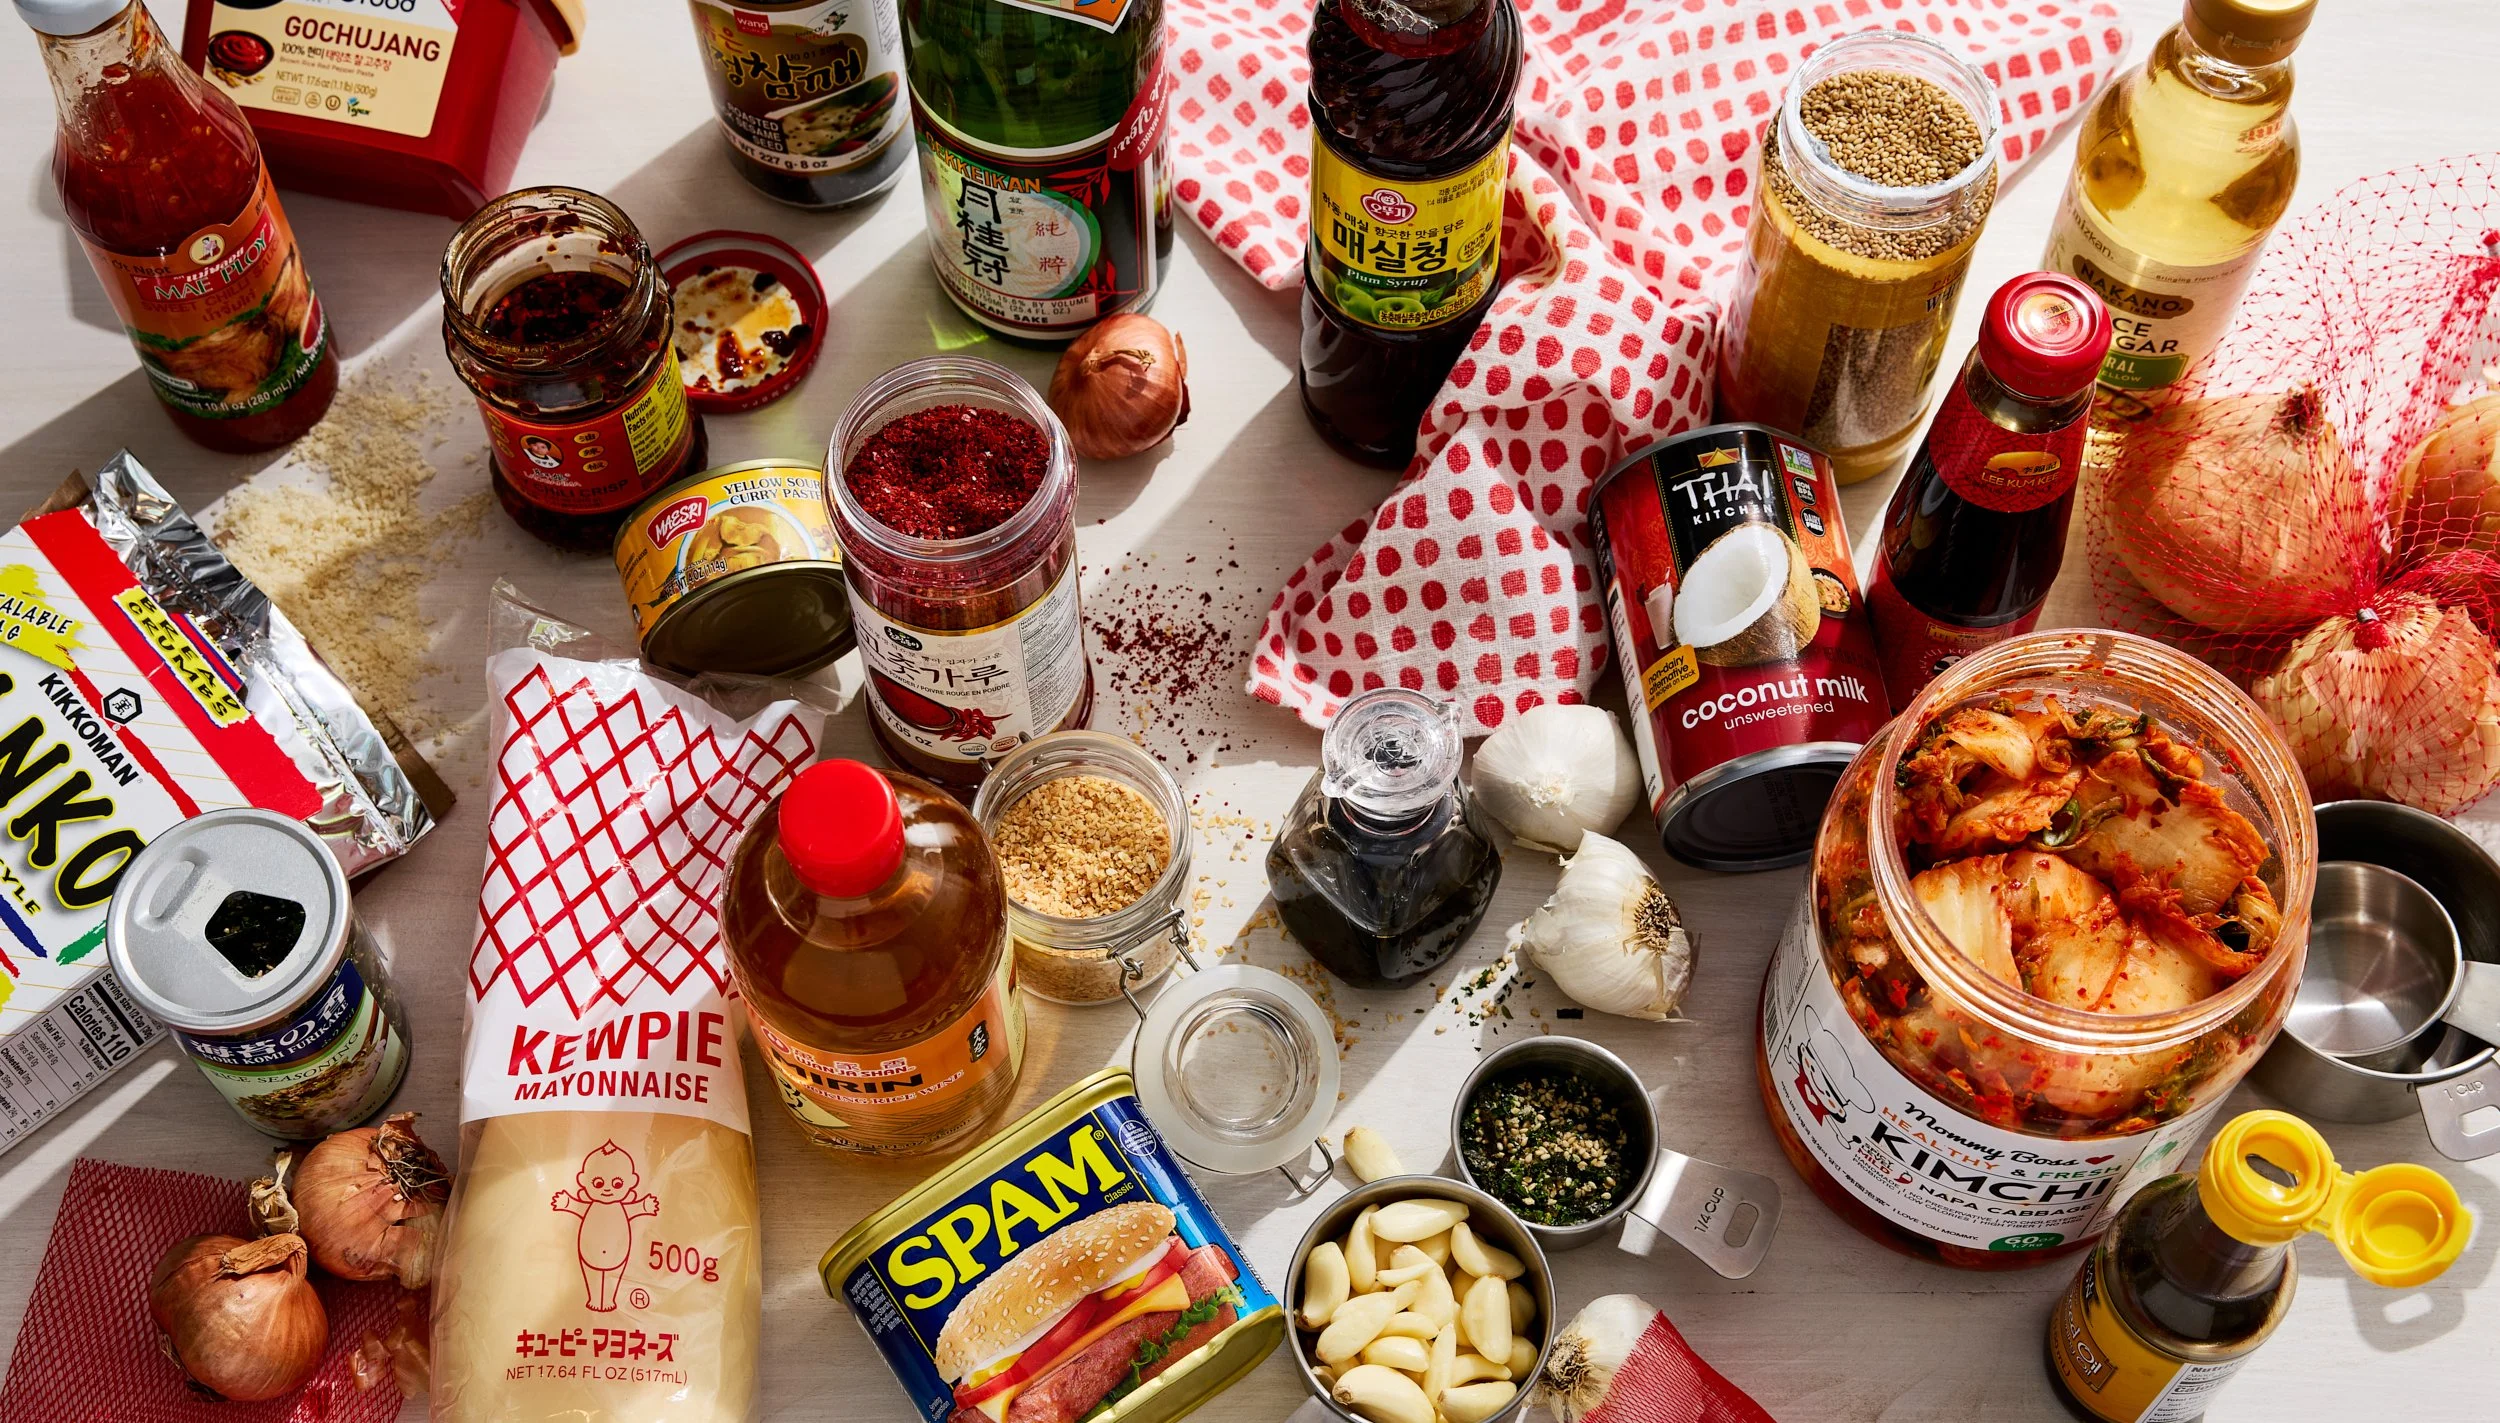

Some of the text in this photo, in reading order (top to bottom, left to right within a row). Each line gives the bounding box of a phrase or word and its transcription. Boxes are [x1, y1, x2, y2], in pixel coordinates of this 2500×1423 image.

[284, 15, 441, 62] GOCHUJANG
[737, 16, 769, 31] wang
[281, 42, 305, 57] 100%
[727, 102, 779, 133] ROASTED
[736, 118, 782, 143] SESAME
[753, 135, 784, 152] SEED
[1135, 114, 1163, 156] MARKET
[759, 152, 780, 166] 227
[924, 130, 1042, 195] GEKKEIKAN
[1322, 192, 1465, 241] 하동 매실 향긋한 맛을 담은
[1370, 203, 1408, 219] 오뚜기
[955, 176, 1011, 287] 月桂冠
[1332, 217, 1449, 274] 매실청
[2072, 208, 2113, 259] mizkan
[153, 230, 268, 300] MAE PLOY
[1346, 267, 1429, 288] Plum Syrup
[1050, 297, 1090, 309] VOLUME
[2080, 262, 2181, 312] NAKANO
[1013, 313, 1049, 324] SAKE
[2113, 317, 2153, 337] CE
[204, 379, 293, 412] 10 fl oz (280 mL)
[624, 397, 653, 424] Nutrition
[627, 416, 647, 434] Facts
[723, 476, 822, 496] YELLOW SOUR
[728, 486, 823, 506] CURRY PASTE
[1671, 469, 1771, 510] THAI
[1794, 479, 1812, 491] NON
[1797, 487, 1814, 498] BPA
[1981, 471, 2060, 489] LEE KUM KEE
[655, 501, 703, 542] MAESRI
[1692, 503, 1774, 526] KITCHEN
[1804, 511, 1821, 526] DAIRY
[1805, 521, 1823, 532] FREE
[703, 557, 729, 577] (114g)
[128, 601, 229, 717] CRUMBS
[140, 594, 241, 712] BREAD
[889, 671, 917, 690] POWDER
[919, 685, 945, 697] POIVRE
[982, 683, 1011, 695] POUDRE
[1647, 655, 1685, 684] non-dairy
[1648, 664, 1690, 696] alternative
[1673, 680, 1681, 688] on
[1680, 668, 1697, 682] back
[1681, 672, 1870, 730] coconut milk
[1723, 701, 1835, 731] unsweetened
[38, 671, 140, 788] KIKKOMAN
[0, 690, 148, 910] NKO
[0, 866, 42, 916] YLE
[84, 987, 120, 1033] Amount per serving
[102, 973, 146, 1029] Serving size 1/2 Cup
[30, 1031, 49, 1056] Saturated
[41, 1017, 52, 1032] Total
[50, 1028, 60, 1042] Fat
[69, 994, 132, 1062] Calories 110
[202, 1001, 349, 1066] NORI KOMI FURIKAKE
[506, 1010, 727, 1078] KEWPIE
[0, 1047, 26, 1078] Cholesterol
[82, 1041, 96, 1059] Daily
[212, 1071, 252, 1084] RICE
[256, 1032, 359, 1085] SEASONING
[771, 1047, 924, 1095] MIRIN
[513, 1070, 710, 1105] MAYONNAISE
[871, 1092, 917, 1105] RICE
[2444, 1080, 2485, 1101] 1 Cup
[1881, 1106, 2123, 1180] HEALTHY & FRESH
[1904, 1101, 2081, 1168] Mommy Boss
[1857, 1148, 1895, 1176] MILD
[1870, 1120, 2113, 1204] KIMCHI
[1102, 1180, 1135, 1206] Classic
[1852, 1157, 1899, 1191] PROBIOTIC
[1903, 1191, 1925, 1206] LOW
[1924, 1200, 1971, 1223] CALORIES
[1979, 1219, 2003, 1229] HIGH
[1853, 1153, 1901, 1188] HANDMADE
[1909, 1190, 1924, 1201] NO
[1923, 1195, 1994, 1223] PRESERVATIVE
[1918, 1182, 2096, 1218] NAPA CABBAGE
[886, 1122, 1128, 1312] SPAM
[1694, 1187, 1725, 1233] 1/4 Cup
[1897, 1208, 1919, 1224] LOVE
[1919, 1218, 1941, 1232] YOU
[647, 1241, 720, 1284] 500g
[2077, 1341, 2102, 1375] Oil
[505, 1364, 689, 1387] NET 17.64 FL OZ (517mL)
